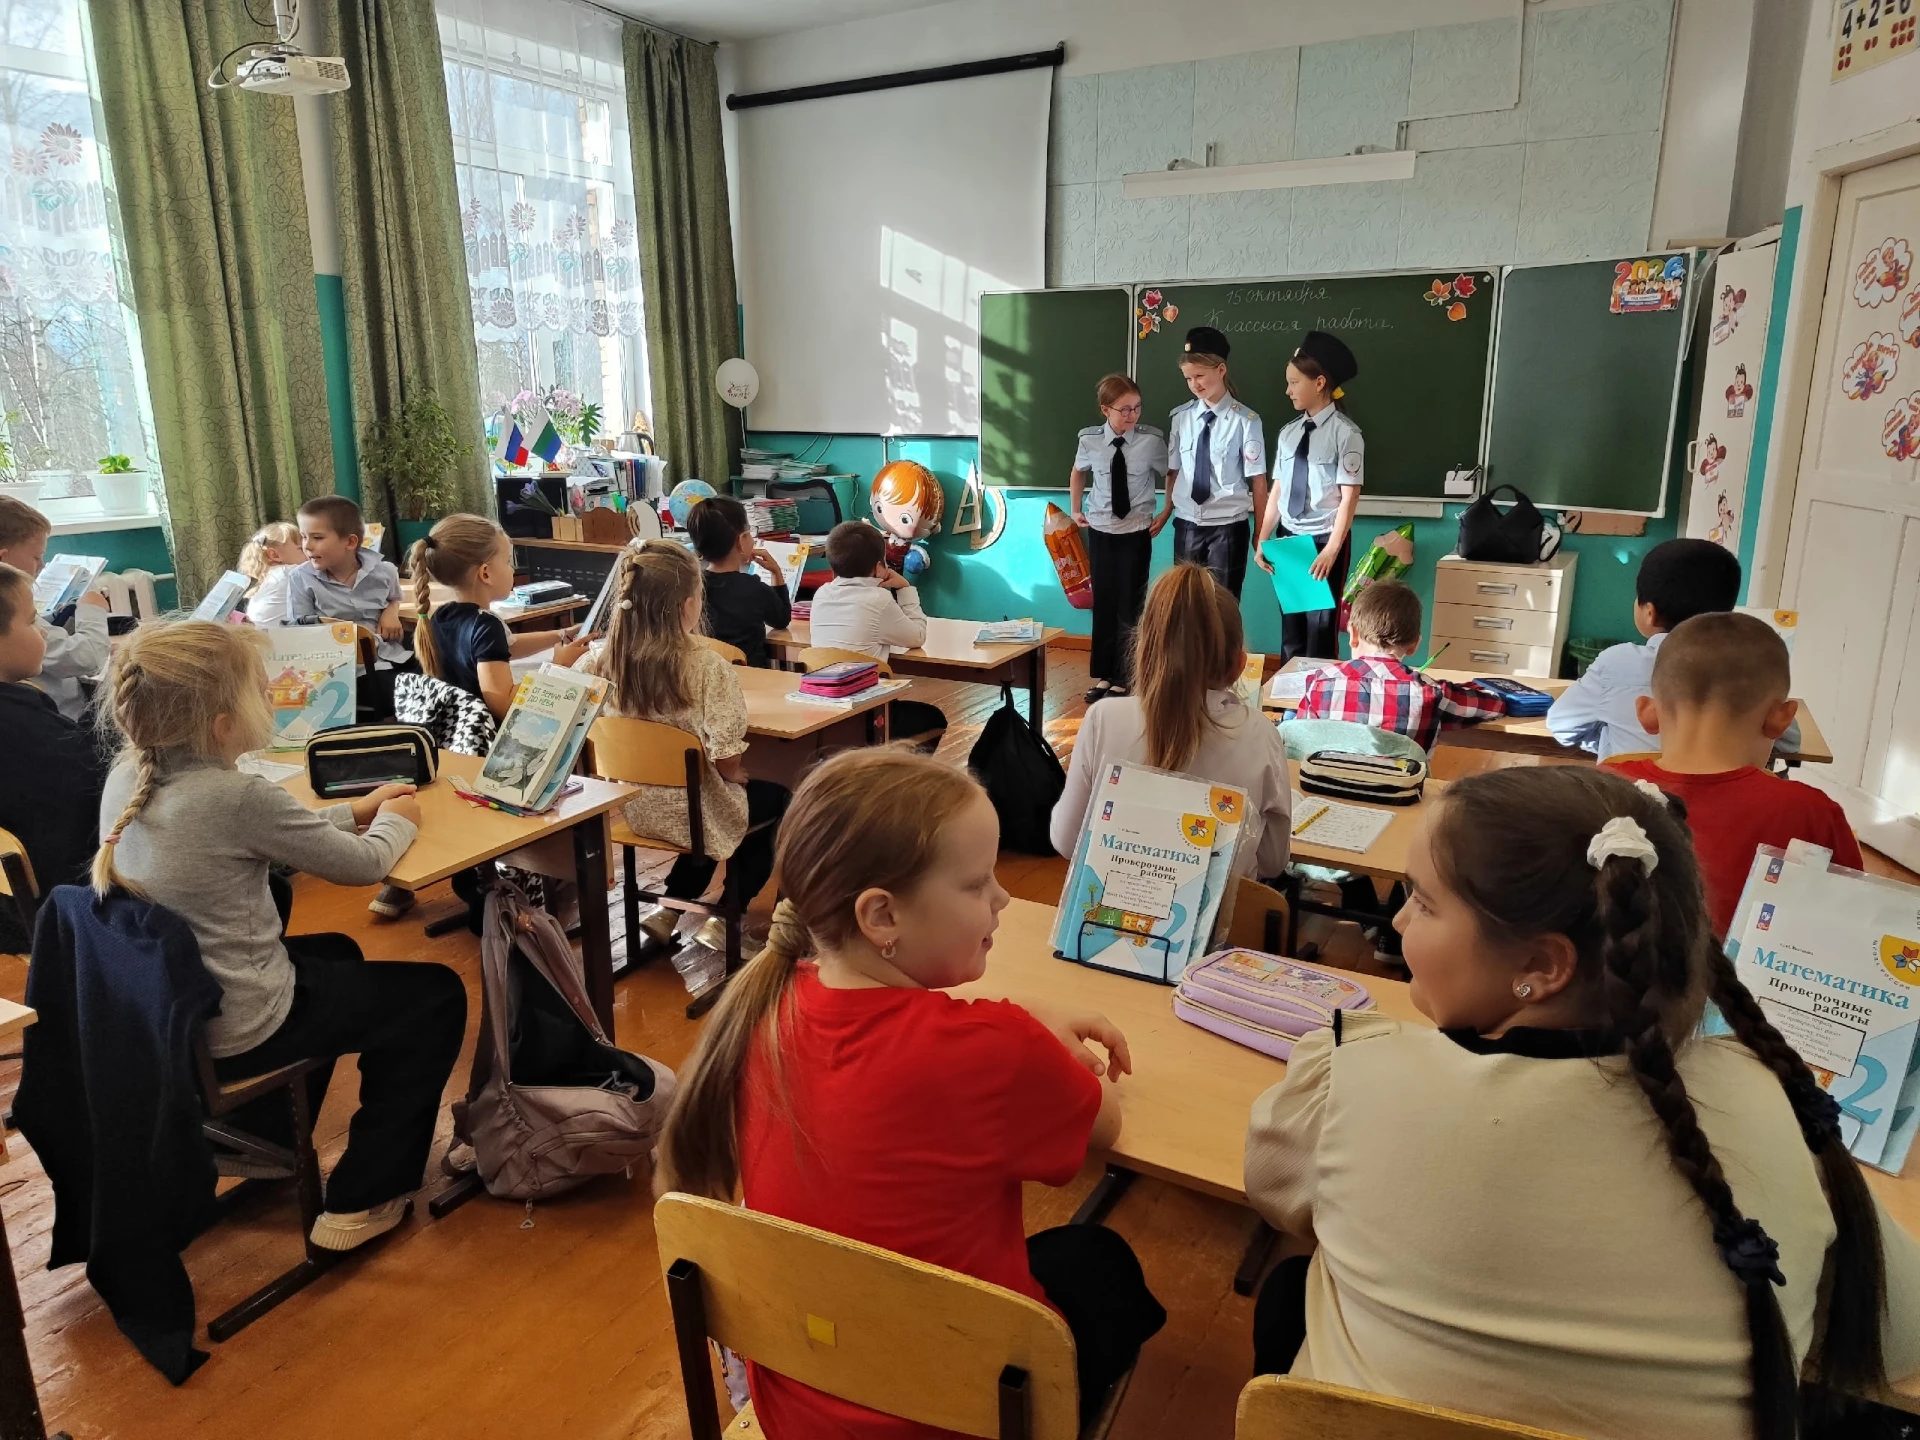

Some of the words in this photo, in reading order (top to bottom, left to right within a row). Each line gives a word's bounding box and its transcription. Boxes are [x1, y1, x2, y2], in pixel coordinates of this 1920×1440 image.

[1613, 257, 1686, 288] 2026
[319, 681, 352, 727] 2
[527, 695, 538, 703] ДО
[539, 697, 555, 708] НЕБА
[1099, 833, 1200, 866] Математика
[1111, 854, 1178, 874] Проверочные
[1140, 869, 1176, 881] работы
[1151, 903, 1187, 954] 2
[1752, 946, 1910, 1010] Математика
[1768, 976, 1873, 1017] Проверочные
[1813, 1002, 1870, 1026] работы
[1838, 1055, 1888, 1125] 2
